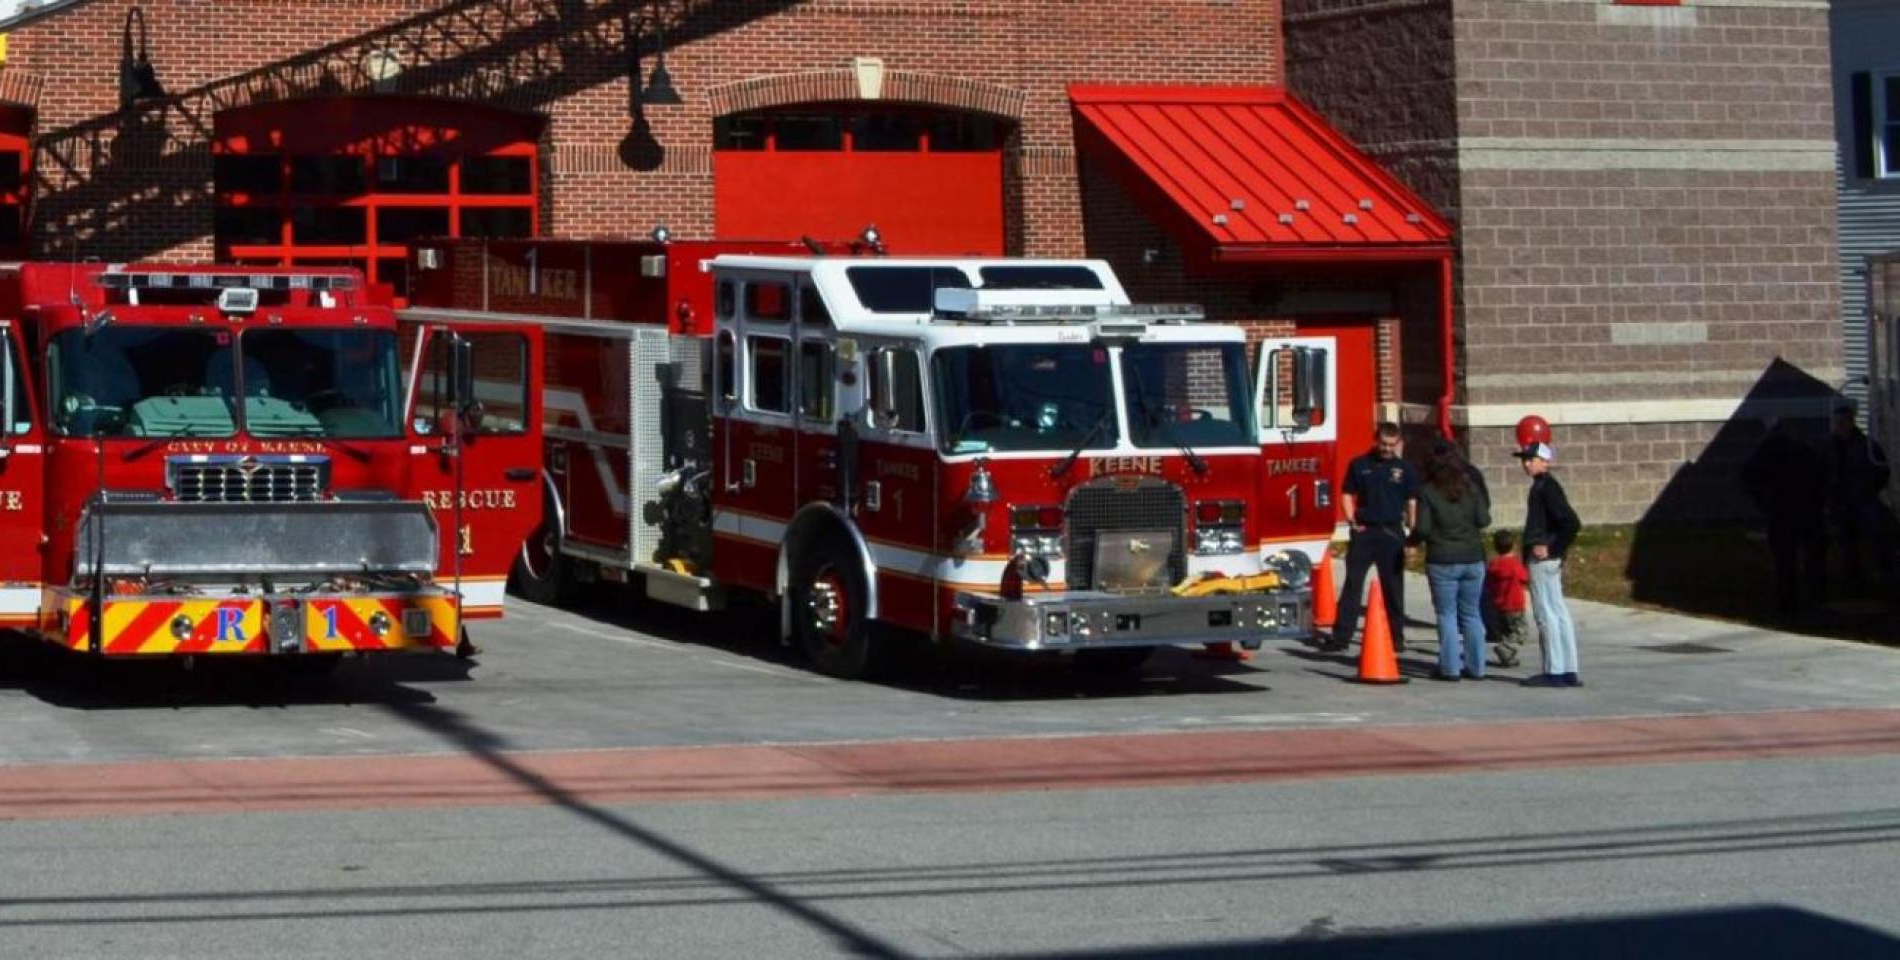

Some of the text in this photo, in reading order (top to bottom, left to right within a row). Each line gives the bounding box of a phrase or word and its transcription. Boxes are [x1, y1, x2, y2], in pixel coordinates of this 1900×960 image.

[167, 441, 215, 453] CITY
[1089, 456, 1163, 477] KEENE
[1285, 484, 1298, 518] 1
[458, 523, 474, 555] 1
[217, 604, 337, 641] R 1
